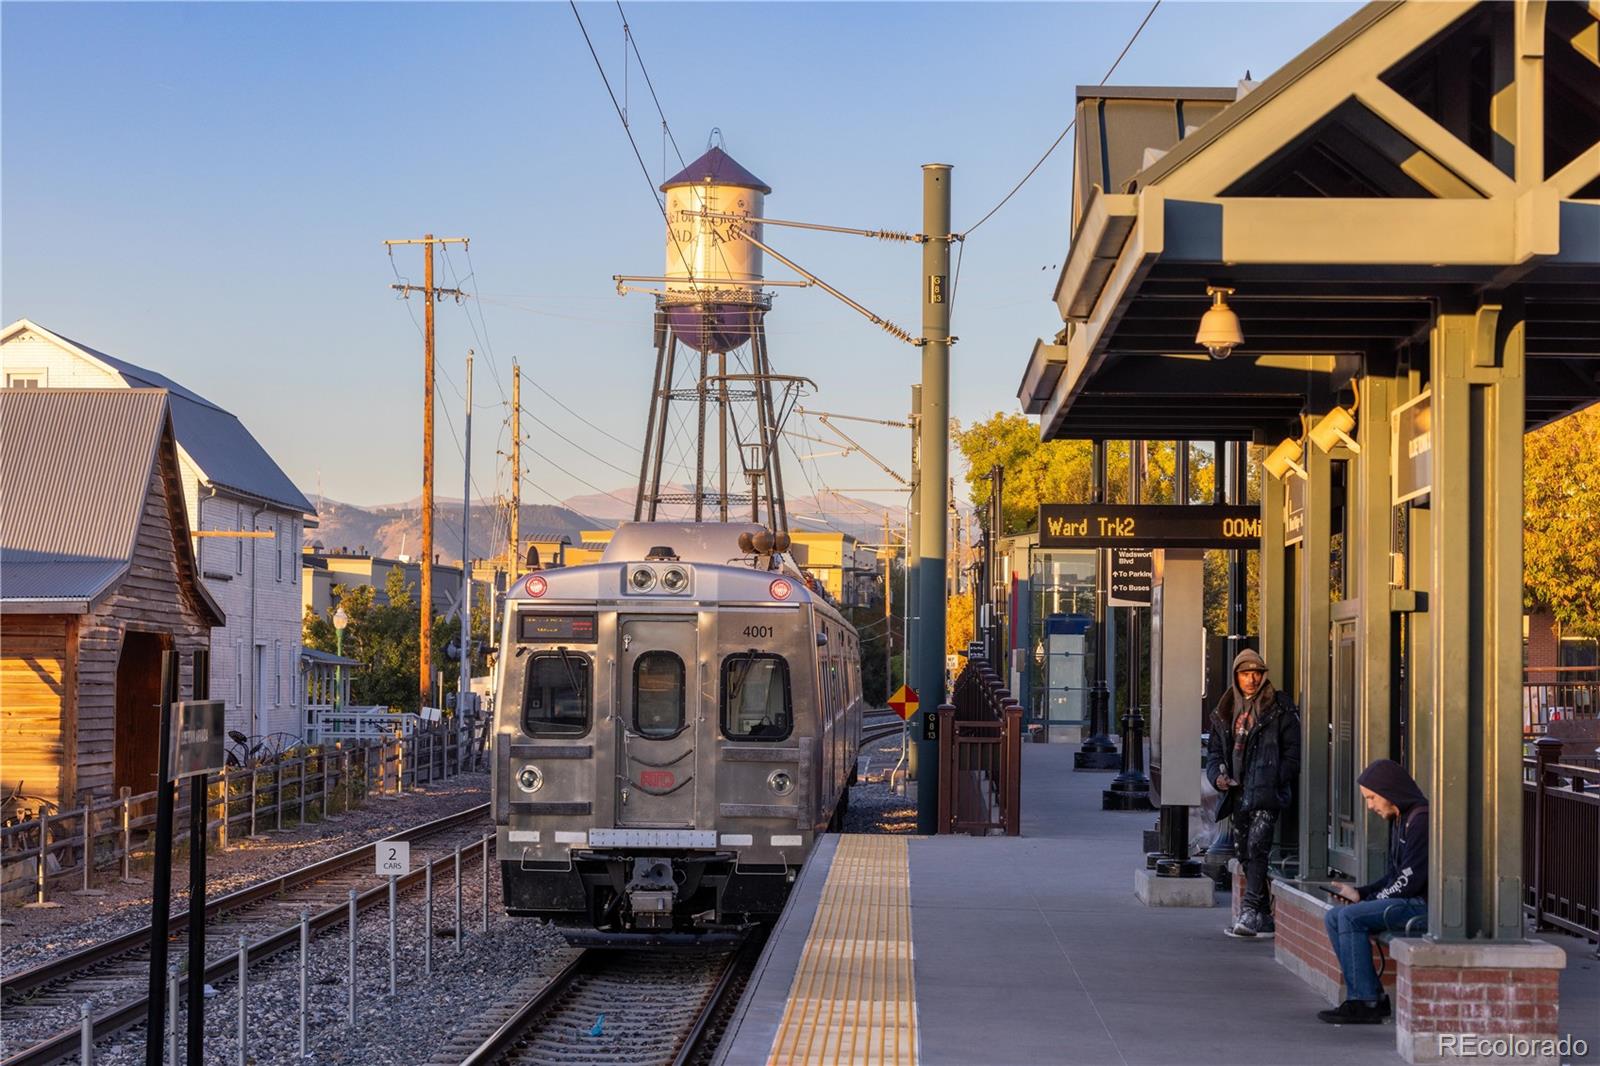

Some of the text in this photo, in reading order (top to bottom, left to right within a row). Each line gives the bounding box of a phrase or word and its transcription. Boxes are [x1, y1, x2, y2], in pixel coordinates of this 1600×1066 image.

[1048, 517, 1263, 537] Ward Trk2 00Mi
[743, 626, 774, 638] 4001
[388, 848, 397, 861] 2
